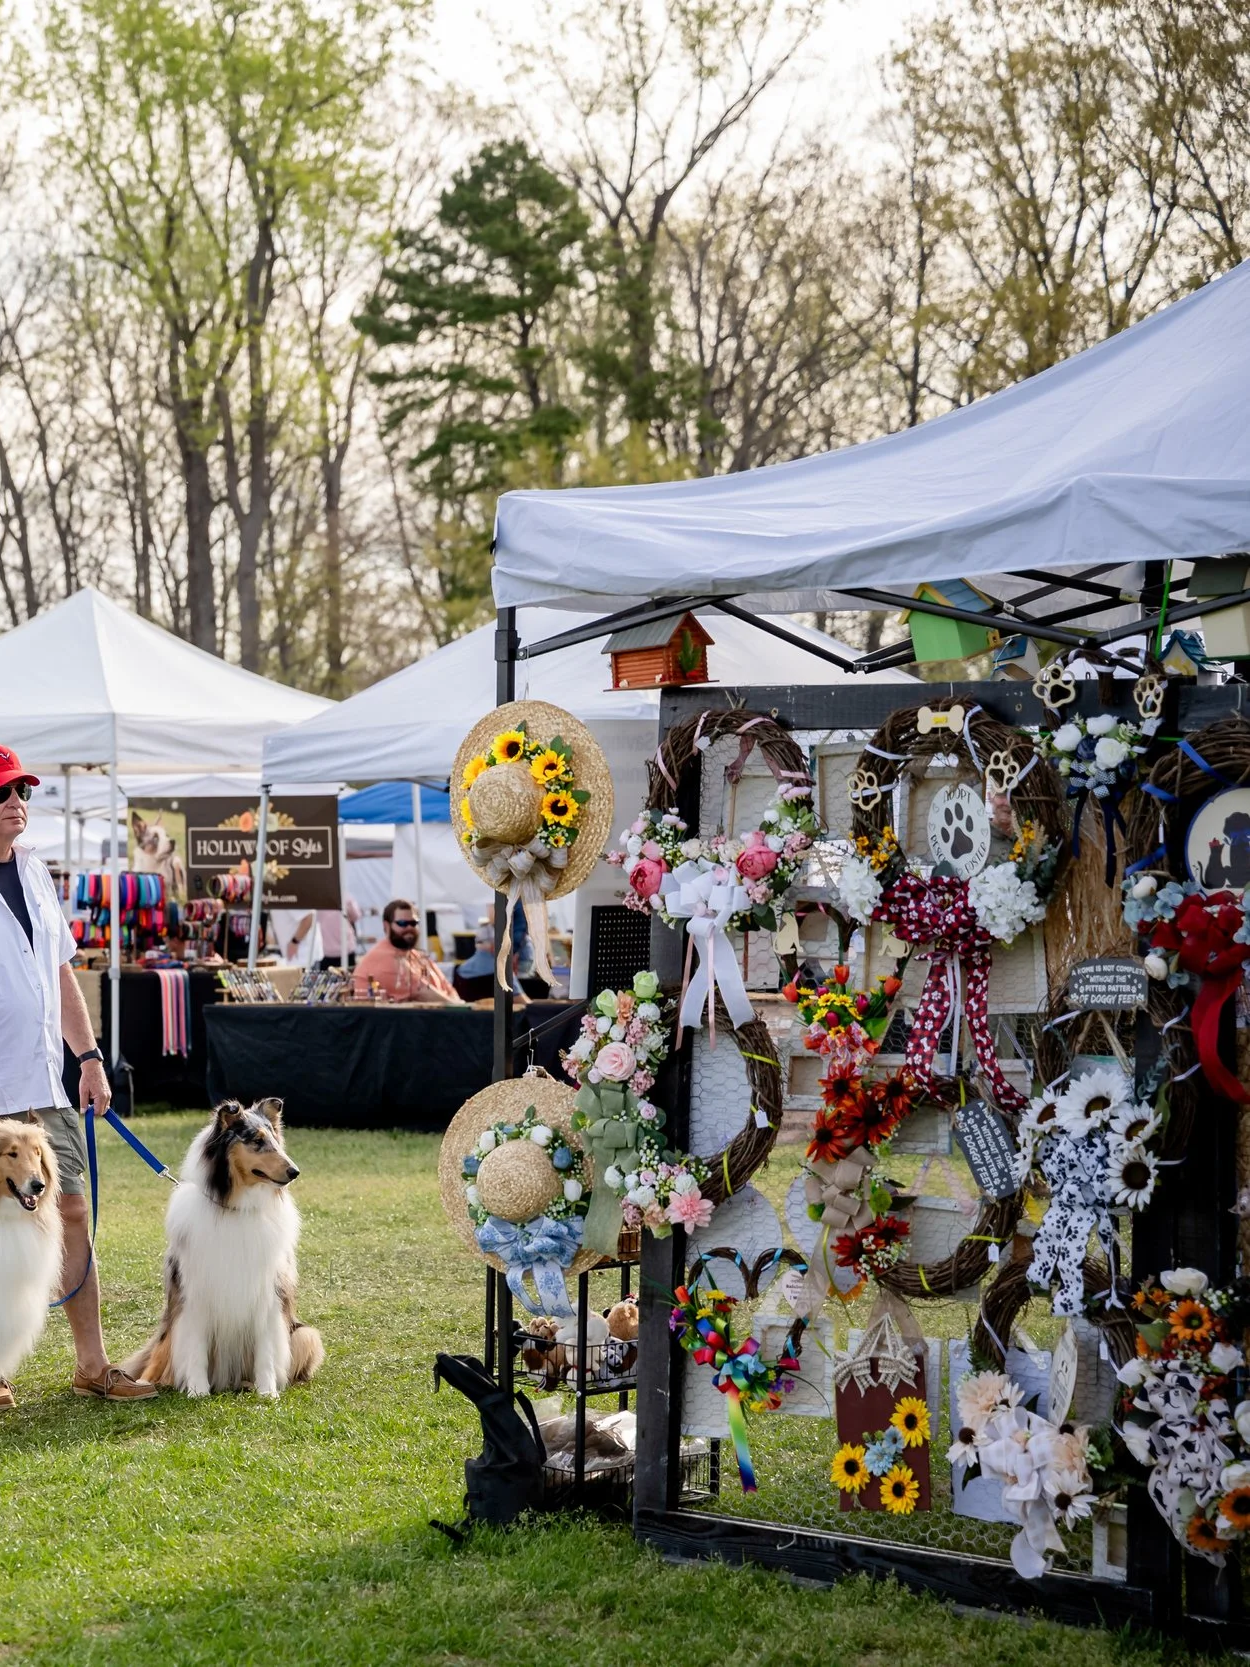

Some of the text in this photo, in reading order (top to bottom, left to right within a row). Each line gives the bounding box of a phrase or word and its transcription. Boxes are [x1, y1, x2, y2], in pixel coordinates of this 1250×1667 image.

[196, 836, 323, 859] HOLLYWOF Styles
[964, 841, 987, 874] FOSTER
[1077, 965, 1095, 975] HOME
[1116, 965, 1146, 976] COMPLETE
[1090, 975, 1127, 983] WITHOUT THE
[1085, 984, 1131, 992] PITTER PATTER
[1079, 994, 1136, 1004] OF DOGGY FEET
[993, 1127, 1002, 1135] IS
[981, 1124, 1005, 1169] WITHOUT THE
[997, 1135, 1008, 1150] NOT
[971, 1123, 1001, 1178] PITTER PATTER
[963, 1134, 984, 1165] DOGGY
[977, 1166, 995, 1188] FEET
